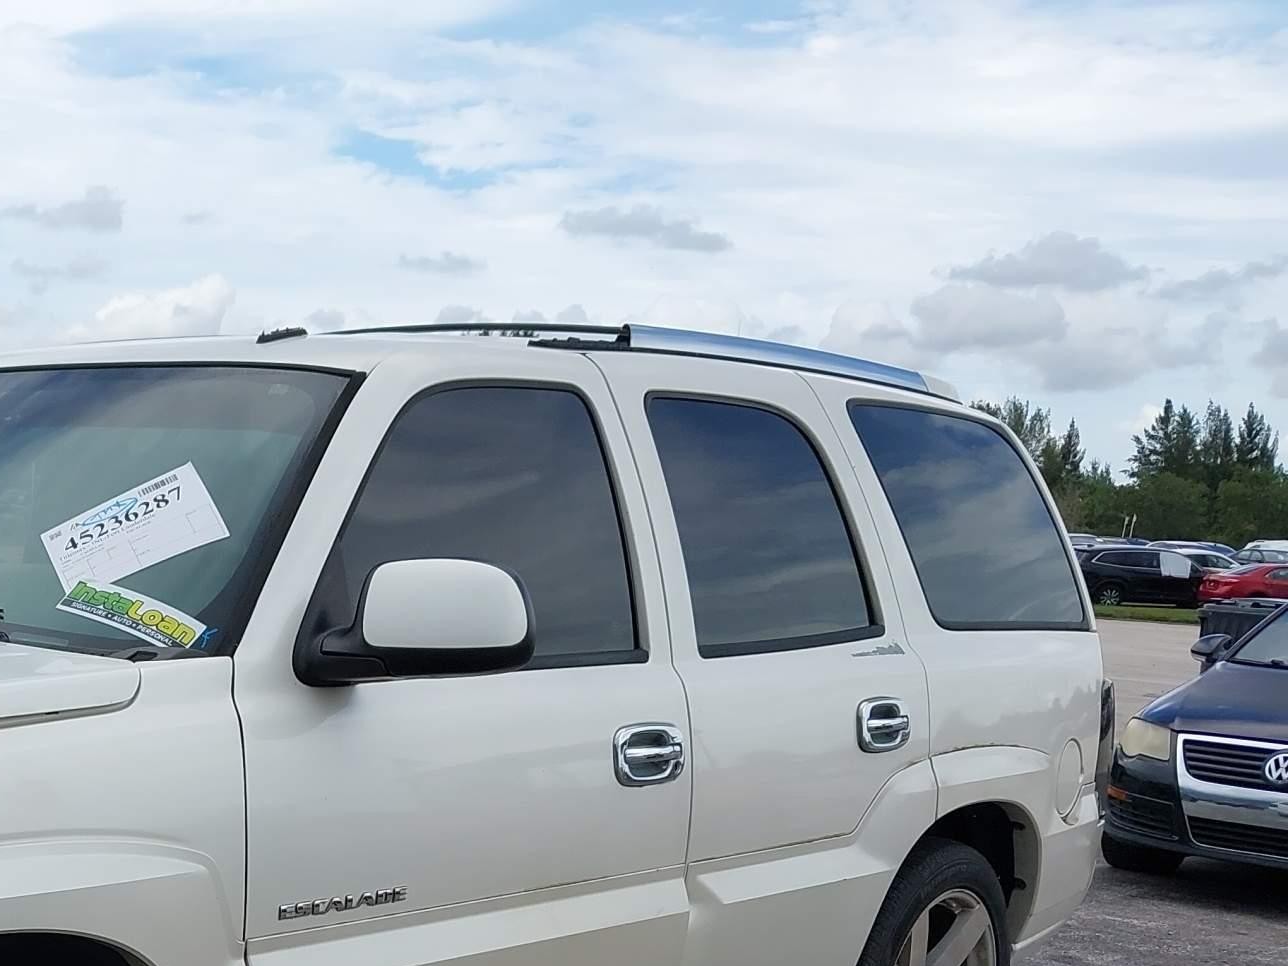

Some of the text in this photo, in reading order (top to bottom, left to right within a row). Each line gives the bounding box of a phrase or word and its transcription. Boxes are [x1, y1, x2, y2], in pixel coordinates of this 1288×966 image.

[64, 486, 181, 551] 45236287
[71, 601, 174, 647] SIGNATURE AUTO PERSONAL
[278, 885, 409, 921] ESCALADE
